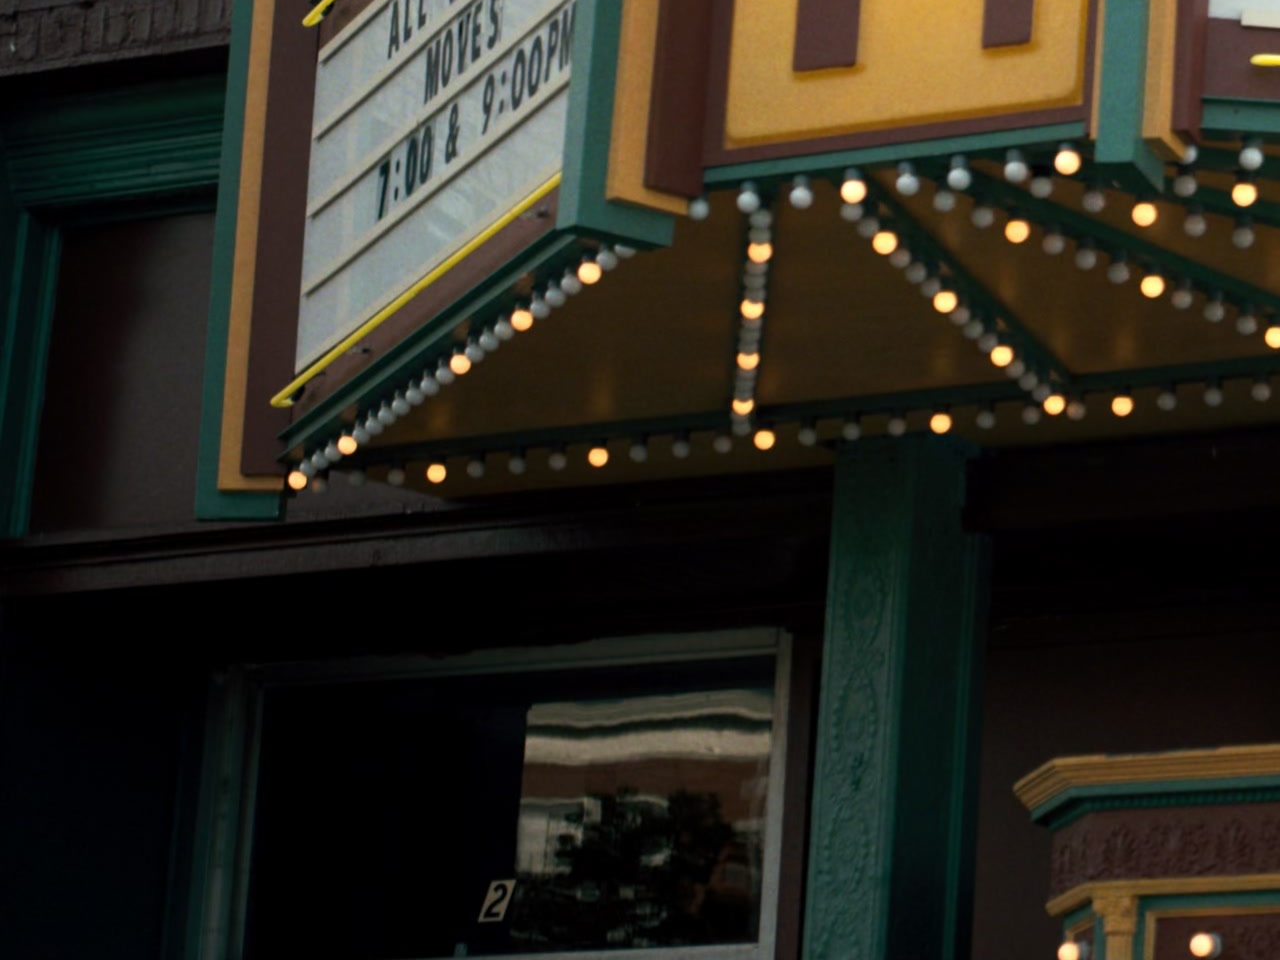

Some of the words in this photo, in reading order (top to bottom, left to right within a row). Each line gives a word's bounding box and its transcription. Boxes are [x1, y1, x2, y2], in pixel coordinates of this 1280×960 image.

[377, 127, 433, 218] 7:00
[444, 102, 460, 163] &
[481, 0, 577, 135] 9:00PM
[483, 883, 507, 918] 2
